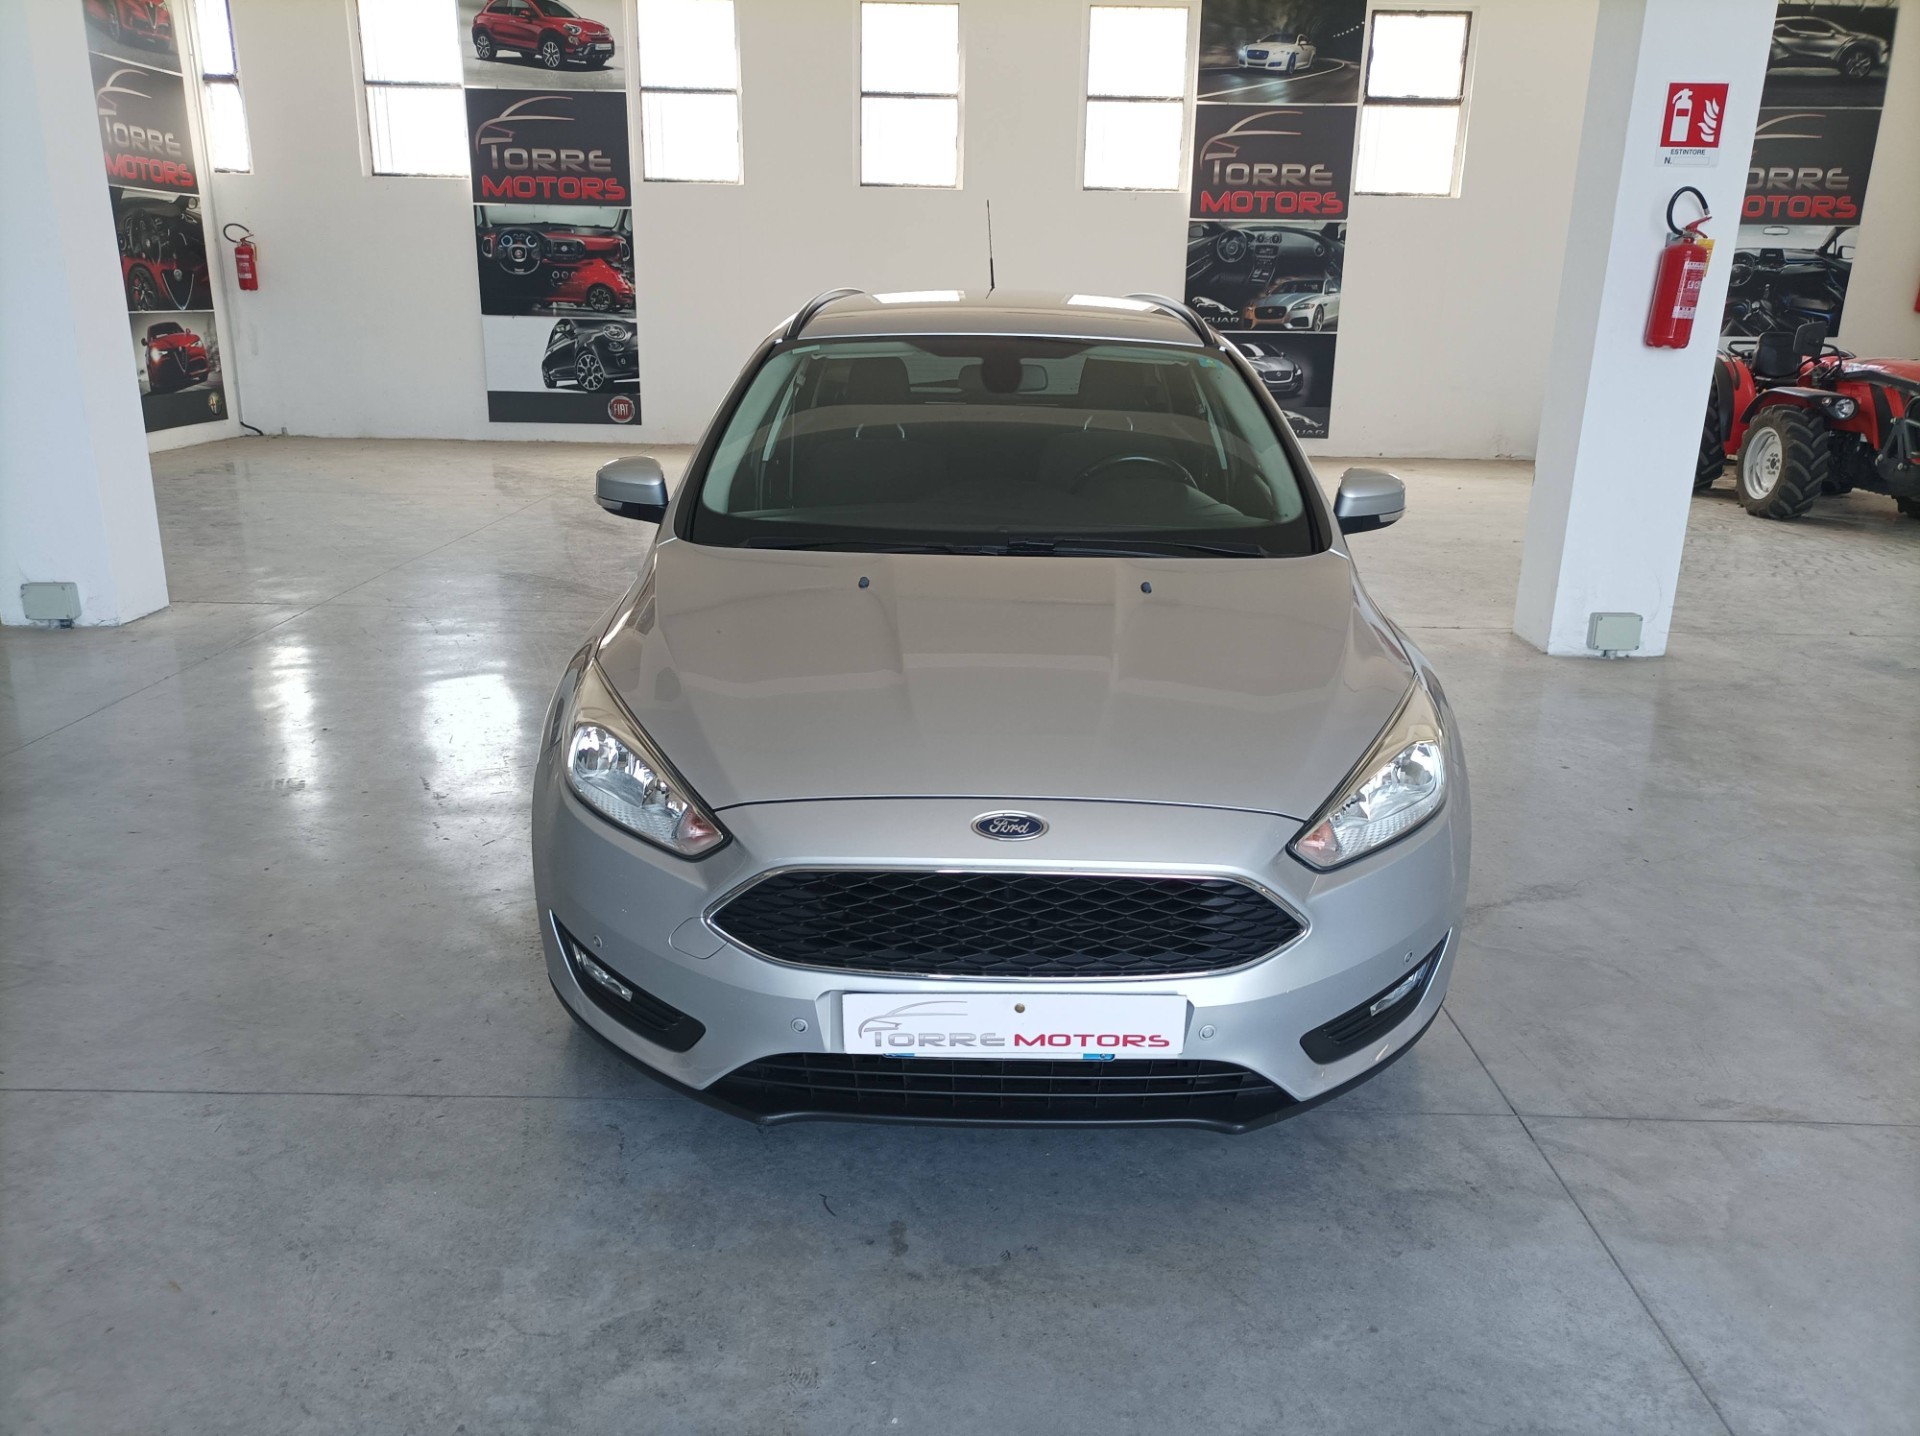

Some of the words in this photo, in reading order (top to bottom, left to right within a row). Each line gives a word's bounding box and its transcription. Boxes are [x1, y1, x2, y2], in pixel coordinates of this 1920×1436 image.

[98, 107, 182, 157] TORRE
[480, 137, 612, 173] TORRE
[1669, 148, 1706, 156] ESTINTORE
[104, 151, 195, 187] MOTORS
[1204, 153, 1333, 187] TORRE
[1745, 167, 1850, 191] ORRE
[481, 174, 626, 201] MOTORS
[1200, 190, 1344, 215] MOTORS
[1742, 195, 1857, 218] OTORS
[613, 403, 629, 416] FIAT
[989, 817, 1030, 834] Ford
[863, 1026, 1005, 1048] TORRE
[1014, 1033, 1170, 1048] MOTORS
